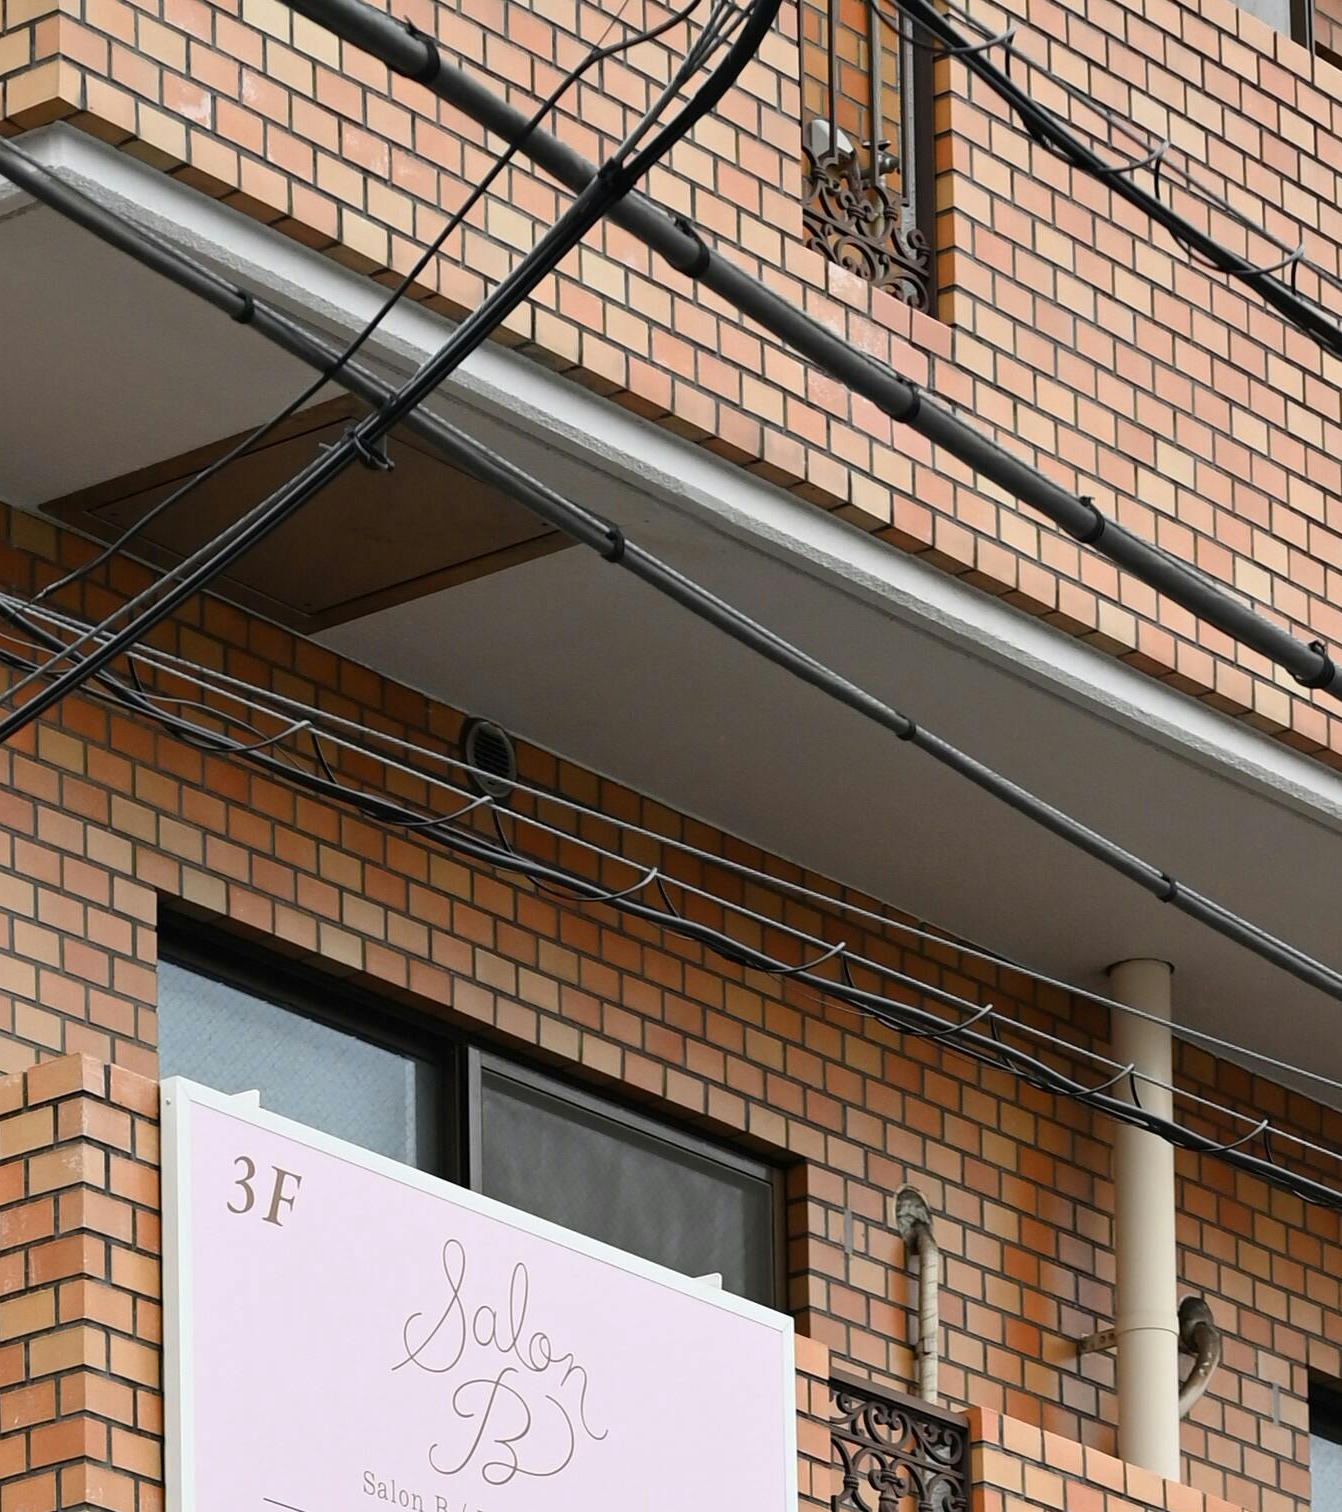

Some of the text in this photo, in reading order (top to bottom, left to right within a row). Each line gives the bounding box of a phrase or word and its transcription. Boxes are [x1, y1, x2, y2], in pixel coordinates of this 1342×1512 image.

[226, 1155, 303, 1228] 3F
[391, 1238, 609, 1442] Salon
[429, 1367, 576, 1487] B
[363, 1470, 425, 1512] Salon
